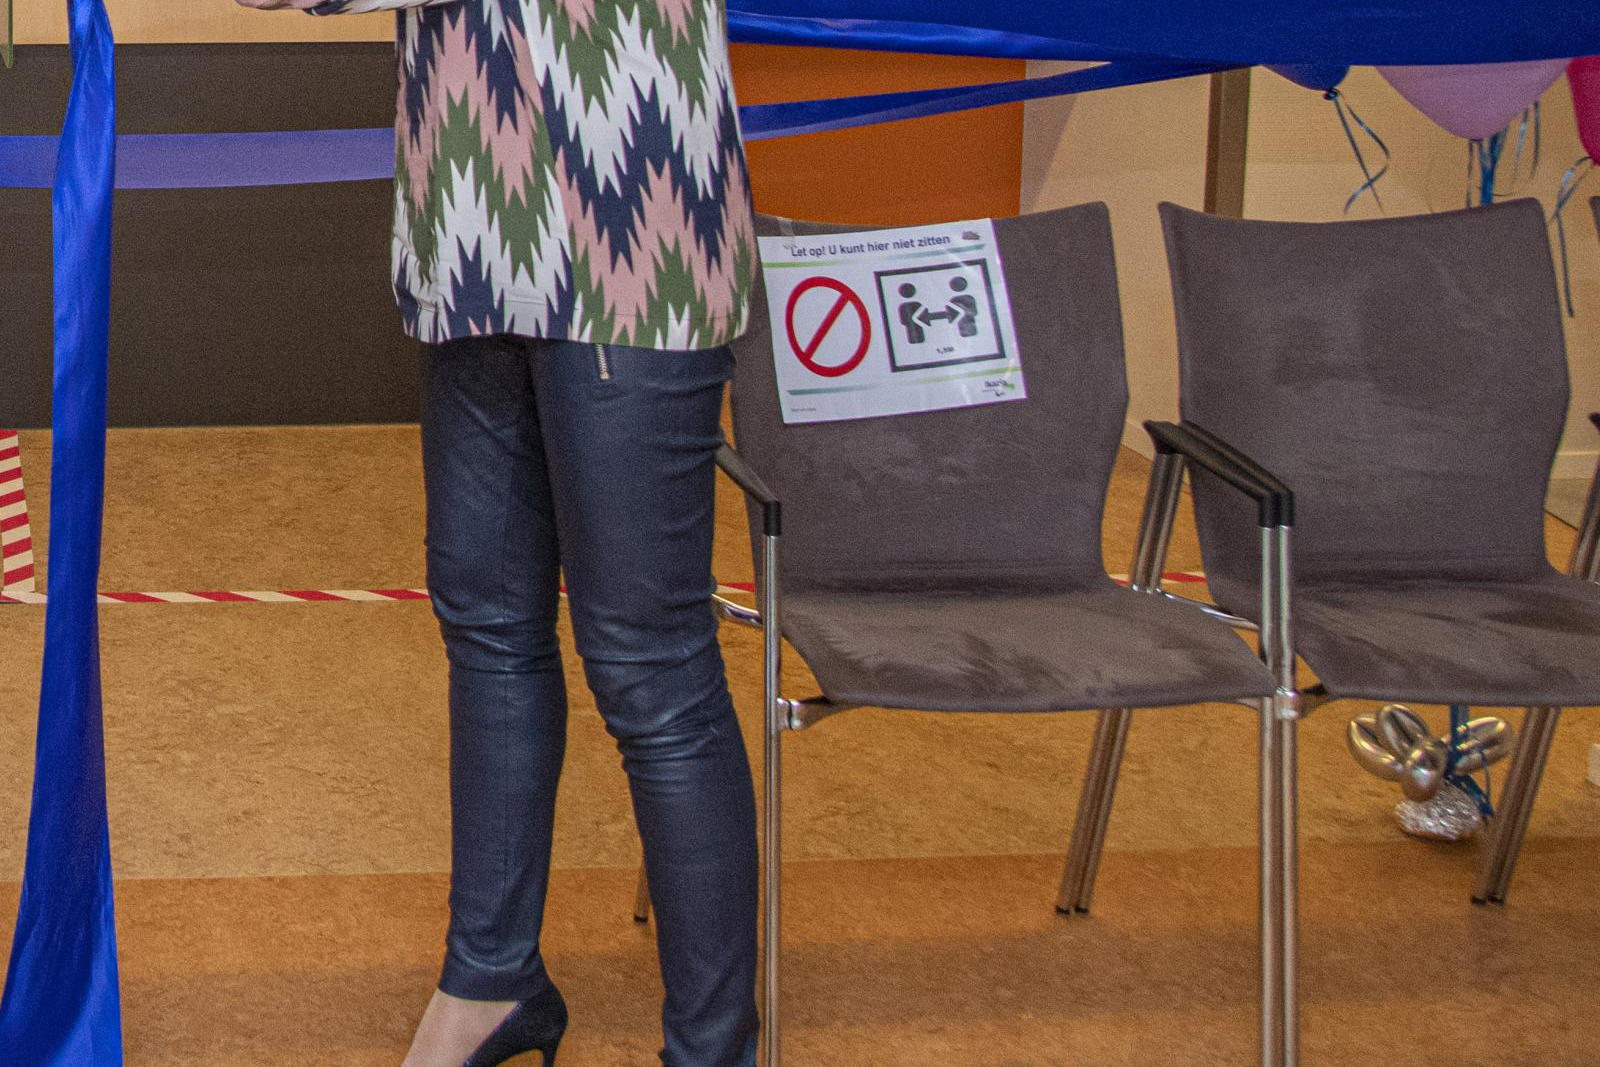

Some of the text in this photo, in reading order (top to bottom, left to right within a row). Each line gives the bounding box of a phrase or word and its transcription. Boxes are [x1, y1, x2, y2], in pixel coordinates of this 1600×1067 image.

[790, 235, 951, 258] Let op! U kunt hier niet zitten
